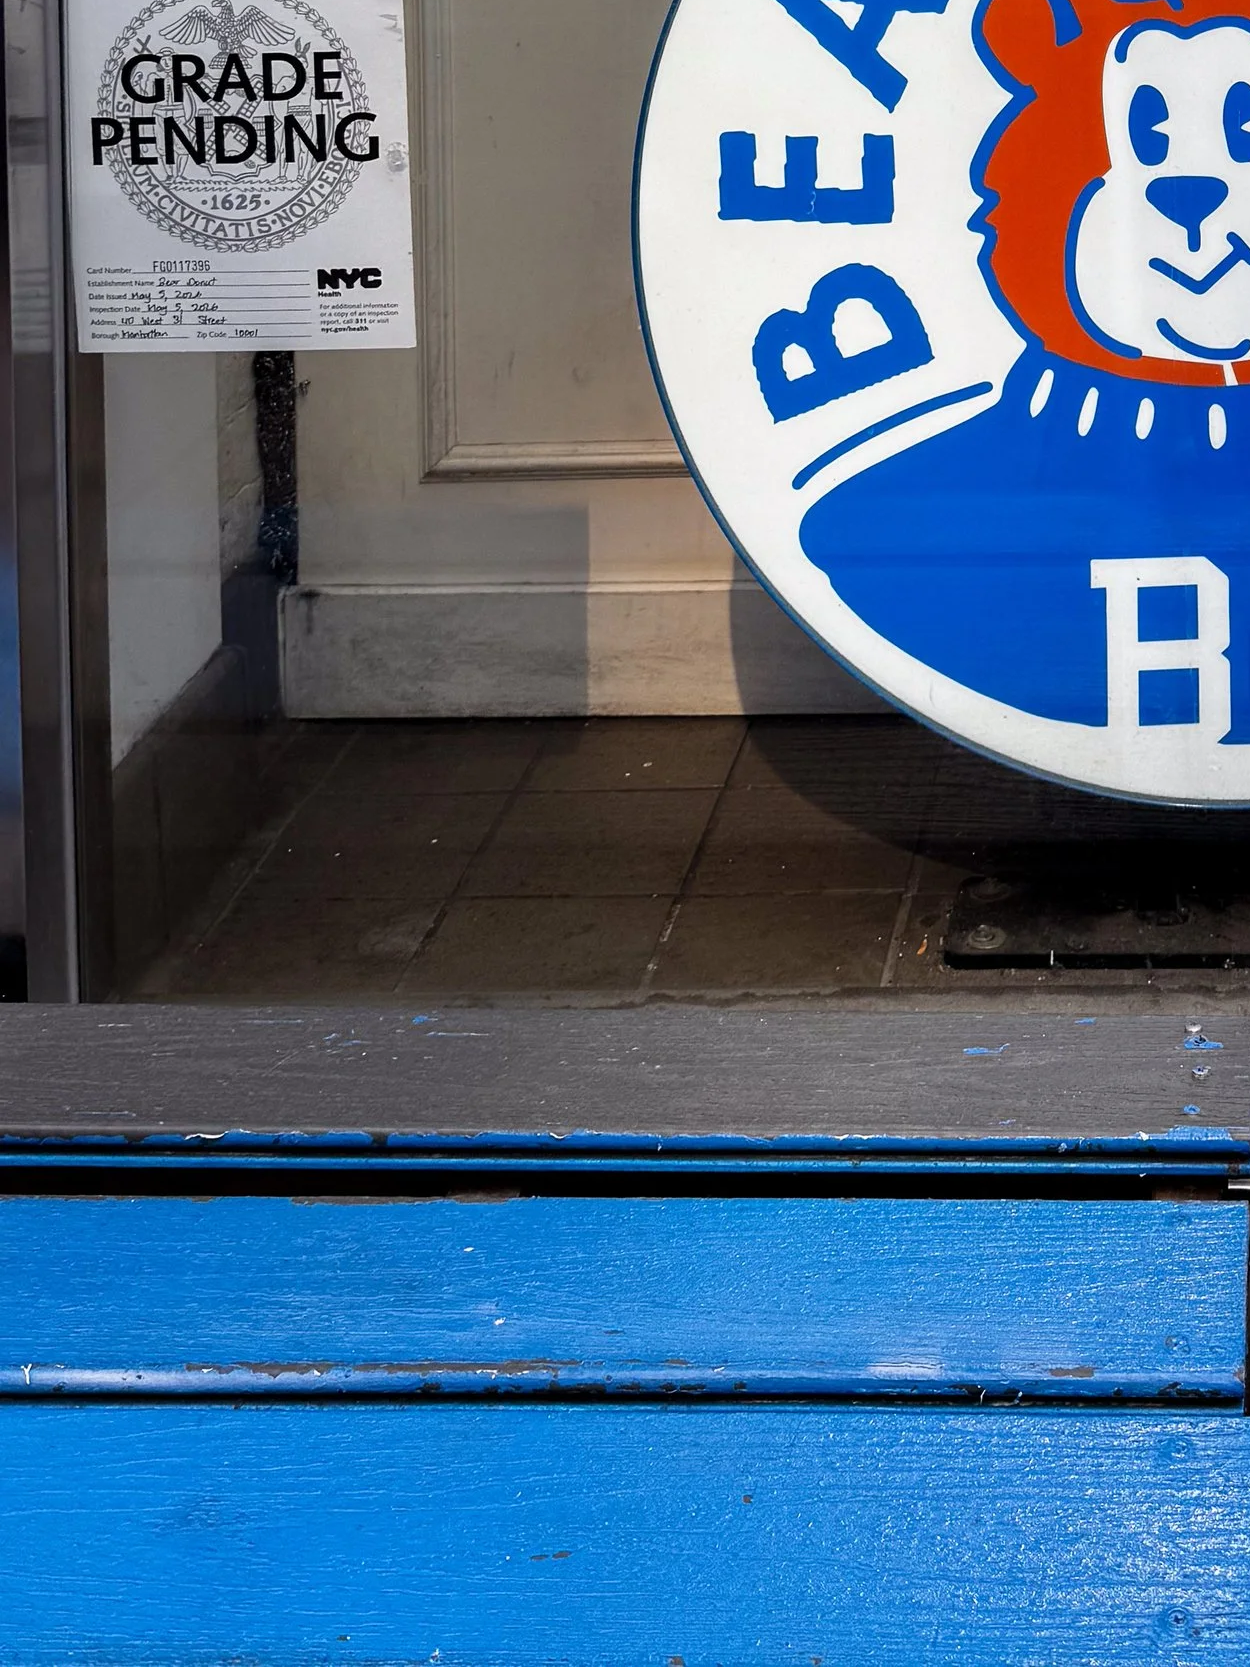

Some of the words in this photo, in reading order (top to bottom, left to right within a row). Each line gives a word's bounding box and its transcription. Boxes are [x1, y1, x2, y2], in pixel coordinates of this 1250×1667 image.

[121, 50, 344, 104] GRADE
[90, 111, 380, 166] PENDING
[211, 194, 262, 211] 1625
[157, 276, 180, 287] Bear
[186, 276, 217, 287] Donut
[317, 267, 382, 289] NYC
[131, 292, 151, 303] May
[89, 306, 123, 314] Inspection
[147, 304, 168, 316] May
[141, 317, 163, 325] West
[198, 315, 227, 325] Street
[91, 332, 120, 340] Borough
